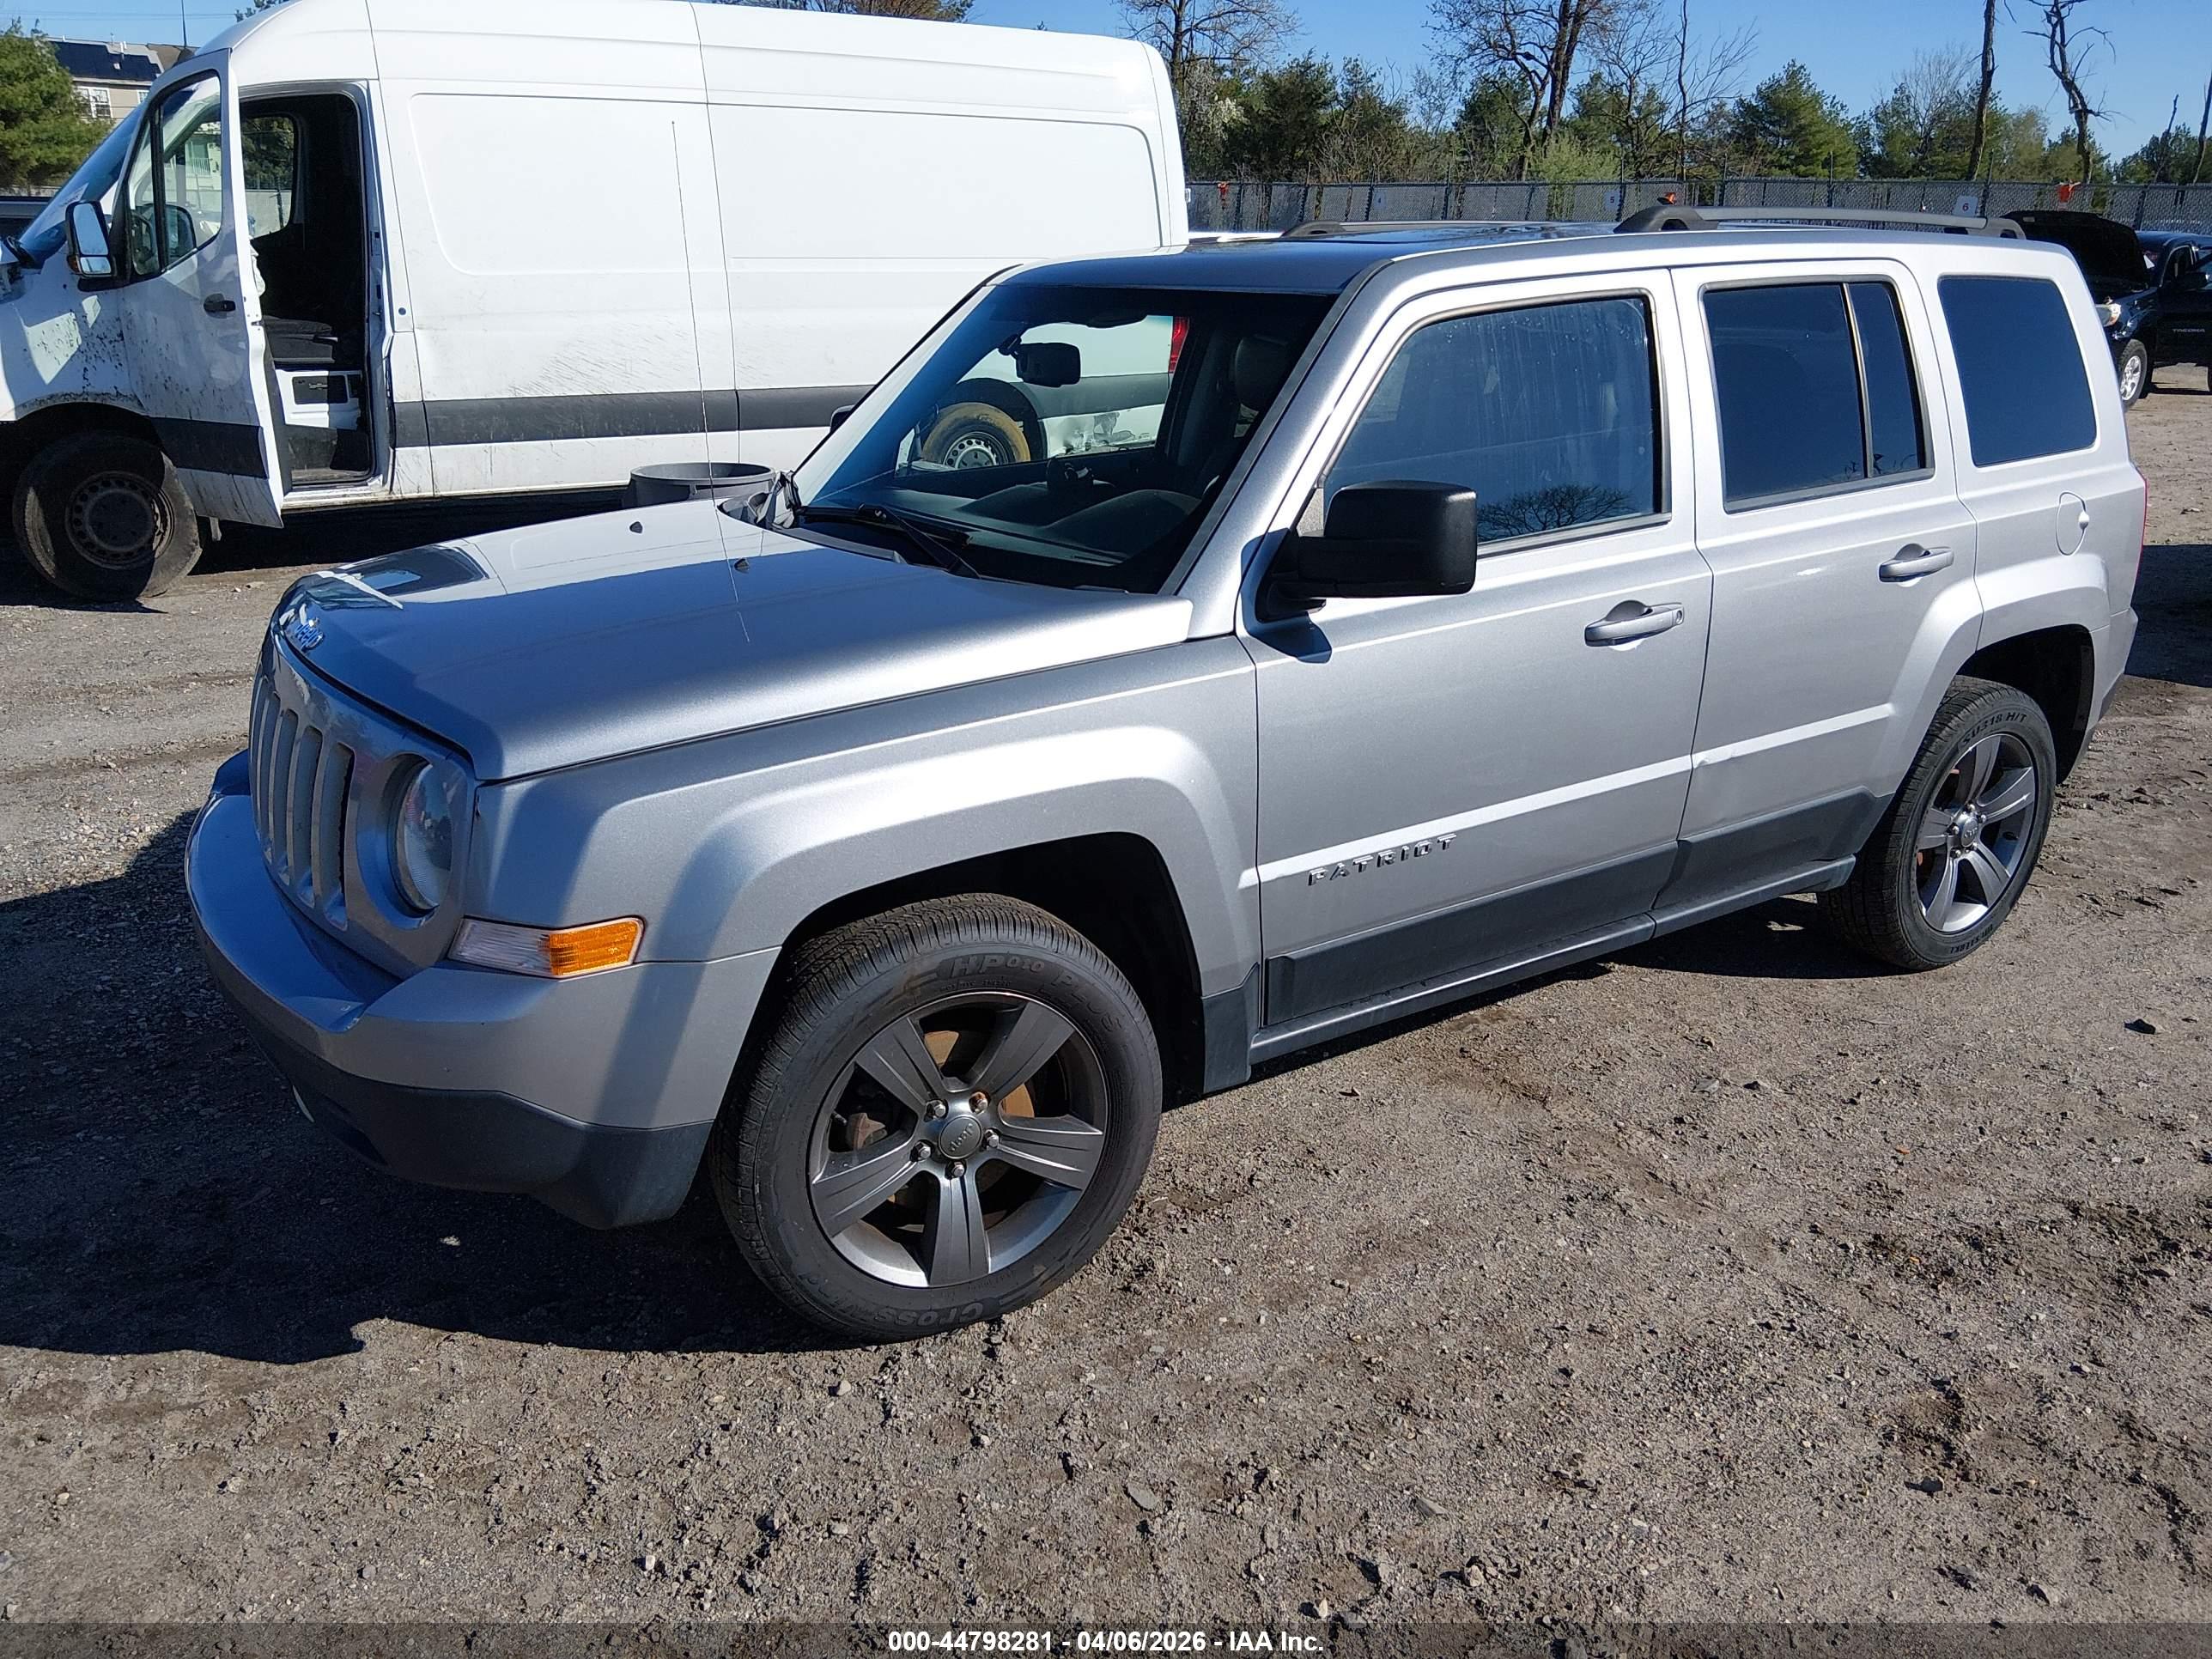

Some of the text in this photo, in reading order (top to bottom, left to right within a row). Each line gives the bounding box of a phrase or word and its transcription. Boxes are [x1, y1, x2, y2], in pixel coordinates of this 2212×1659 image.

[1962, 203, 1970, 211] 6
[2006, 711, 2027, 723] H/T
[1308, 833, 1457, 886] PATRIOT
